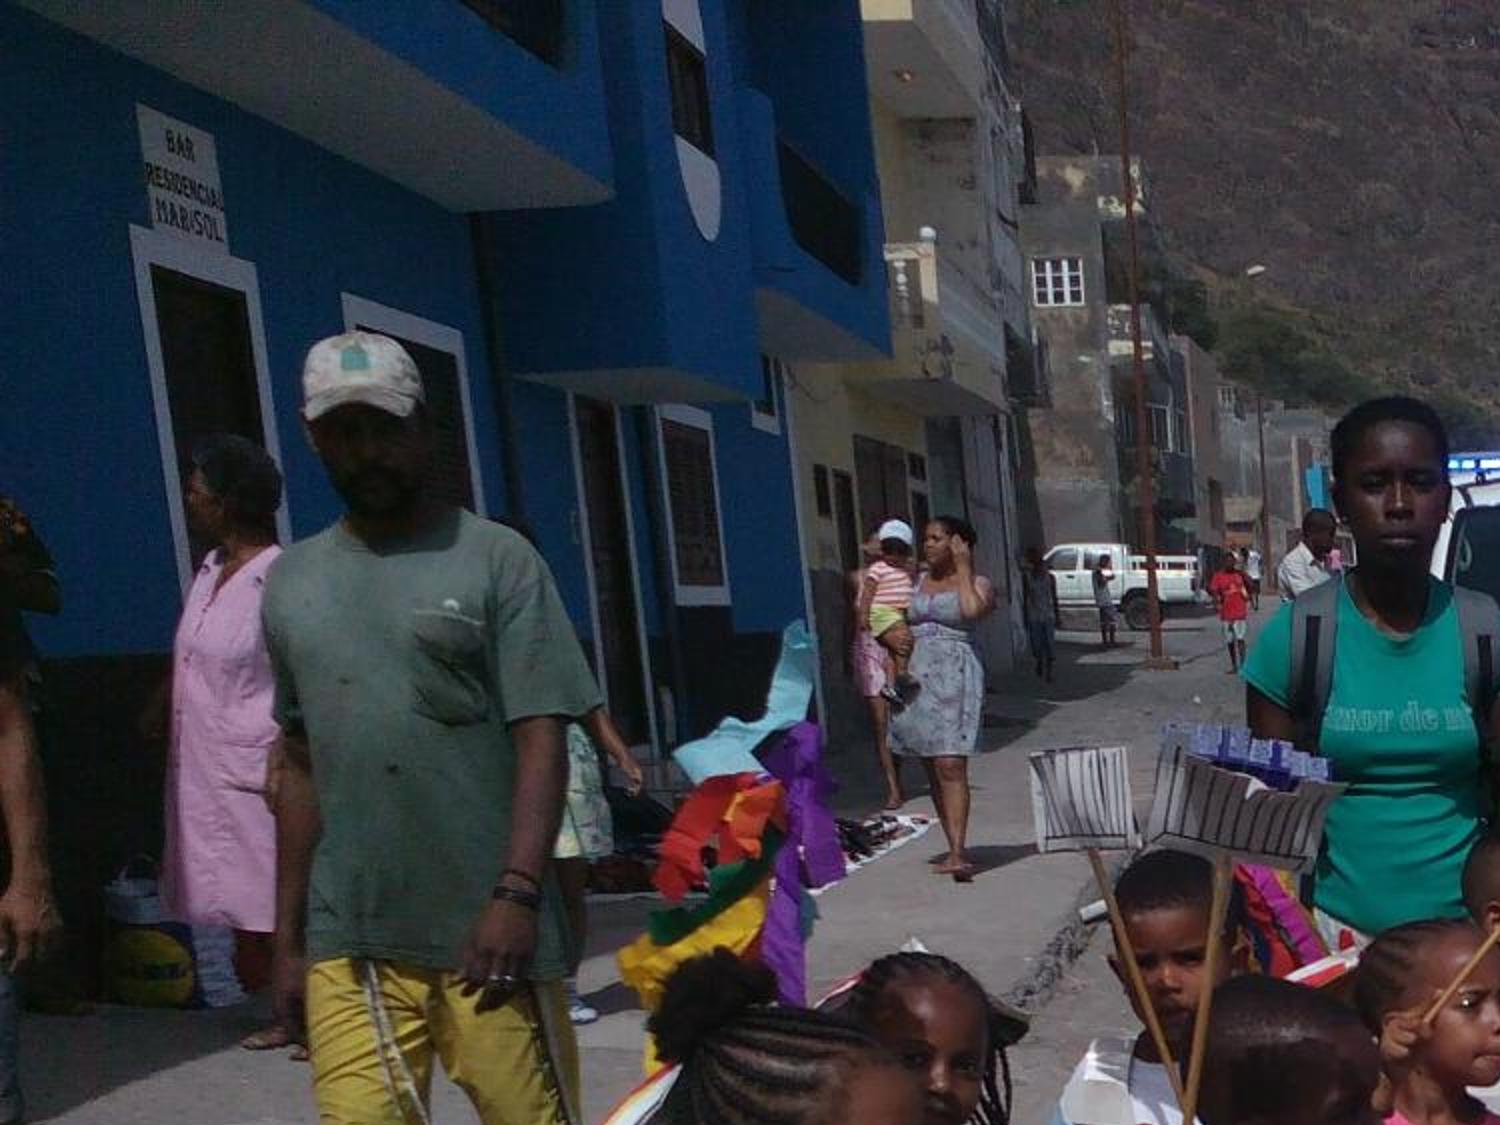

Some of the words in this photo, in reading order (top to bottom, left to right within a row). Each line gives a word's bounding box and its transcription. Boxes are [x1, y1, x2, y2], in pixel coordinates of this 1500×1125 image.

[165, 130, 195, 162] BAR
[145, 162, 224, 211] RESIDENCIAL
[155, 197, 224, 241] MARISOL
